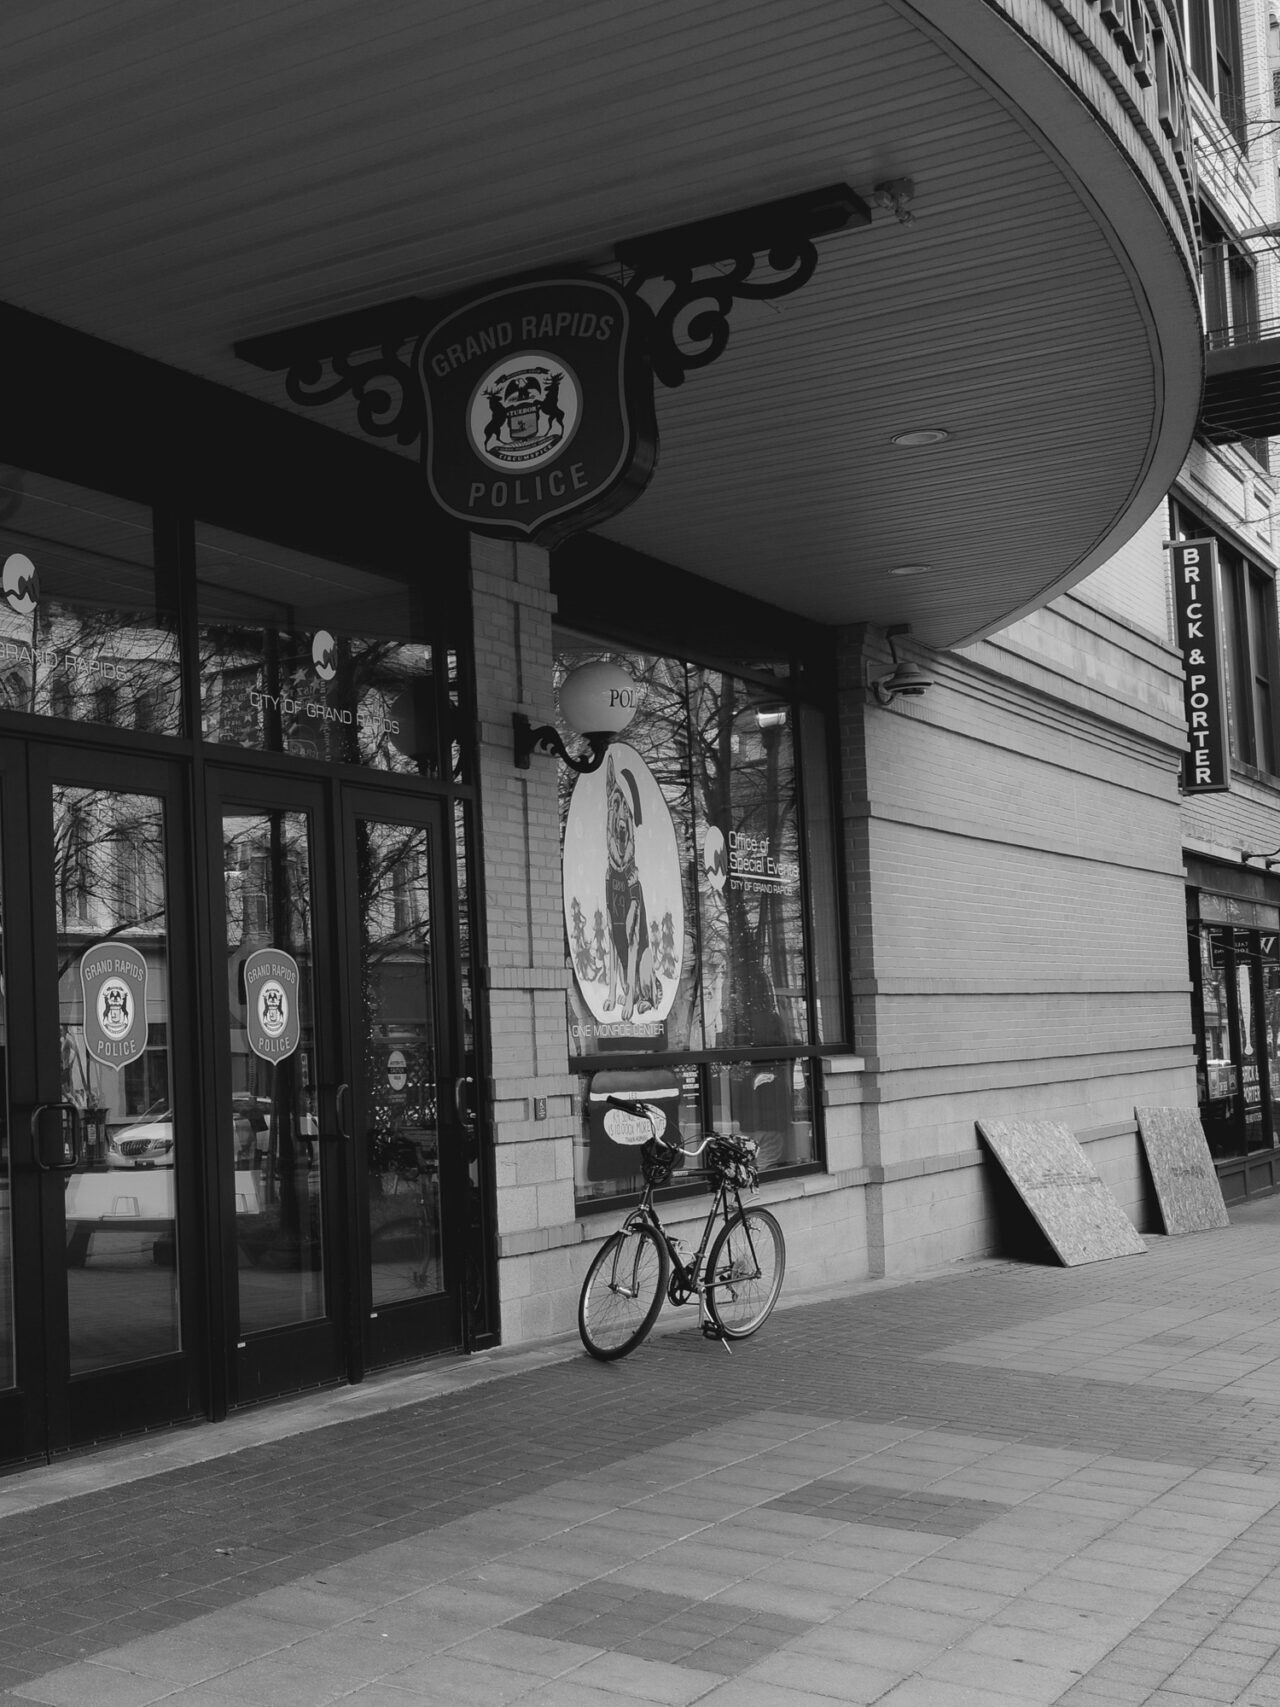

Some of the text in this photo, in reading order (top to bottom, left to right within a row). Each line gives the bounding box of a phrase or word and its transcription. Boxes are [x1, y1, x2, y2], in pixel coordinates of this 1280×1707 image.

[431, 311, 615, 377] GRAND RAPIDS
[468, 462, 588, 507] POLICE
[64, 655, 128, 682] RAPIDS
[1183, 548, 1212, 785] BRICK & PORTER
[249, 692, 400, 735] CITY OF GRAND RAPIDS
[728, 831, 770, 853] Office of
[729, 852, 765, 873] Special
[730, 880, 793, 896] CITY OF GRAND RAPIDS
[84, 959, 145, 982] GRAND RAPIDS
[247, 963, 296, 984] GRAND RAPIDS
[572, 1023, 665, 1037] ONE MONROE CENTER
[97, 1039, 137, 1056] POLICE
[258, 1036, 291, 1052] POLICE
